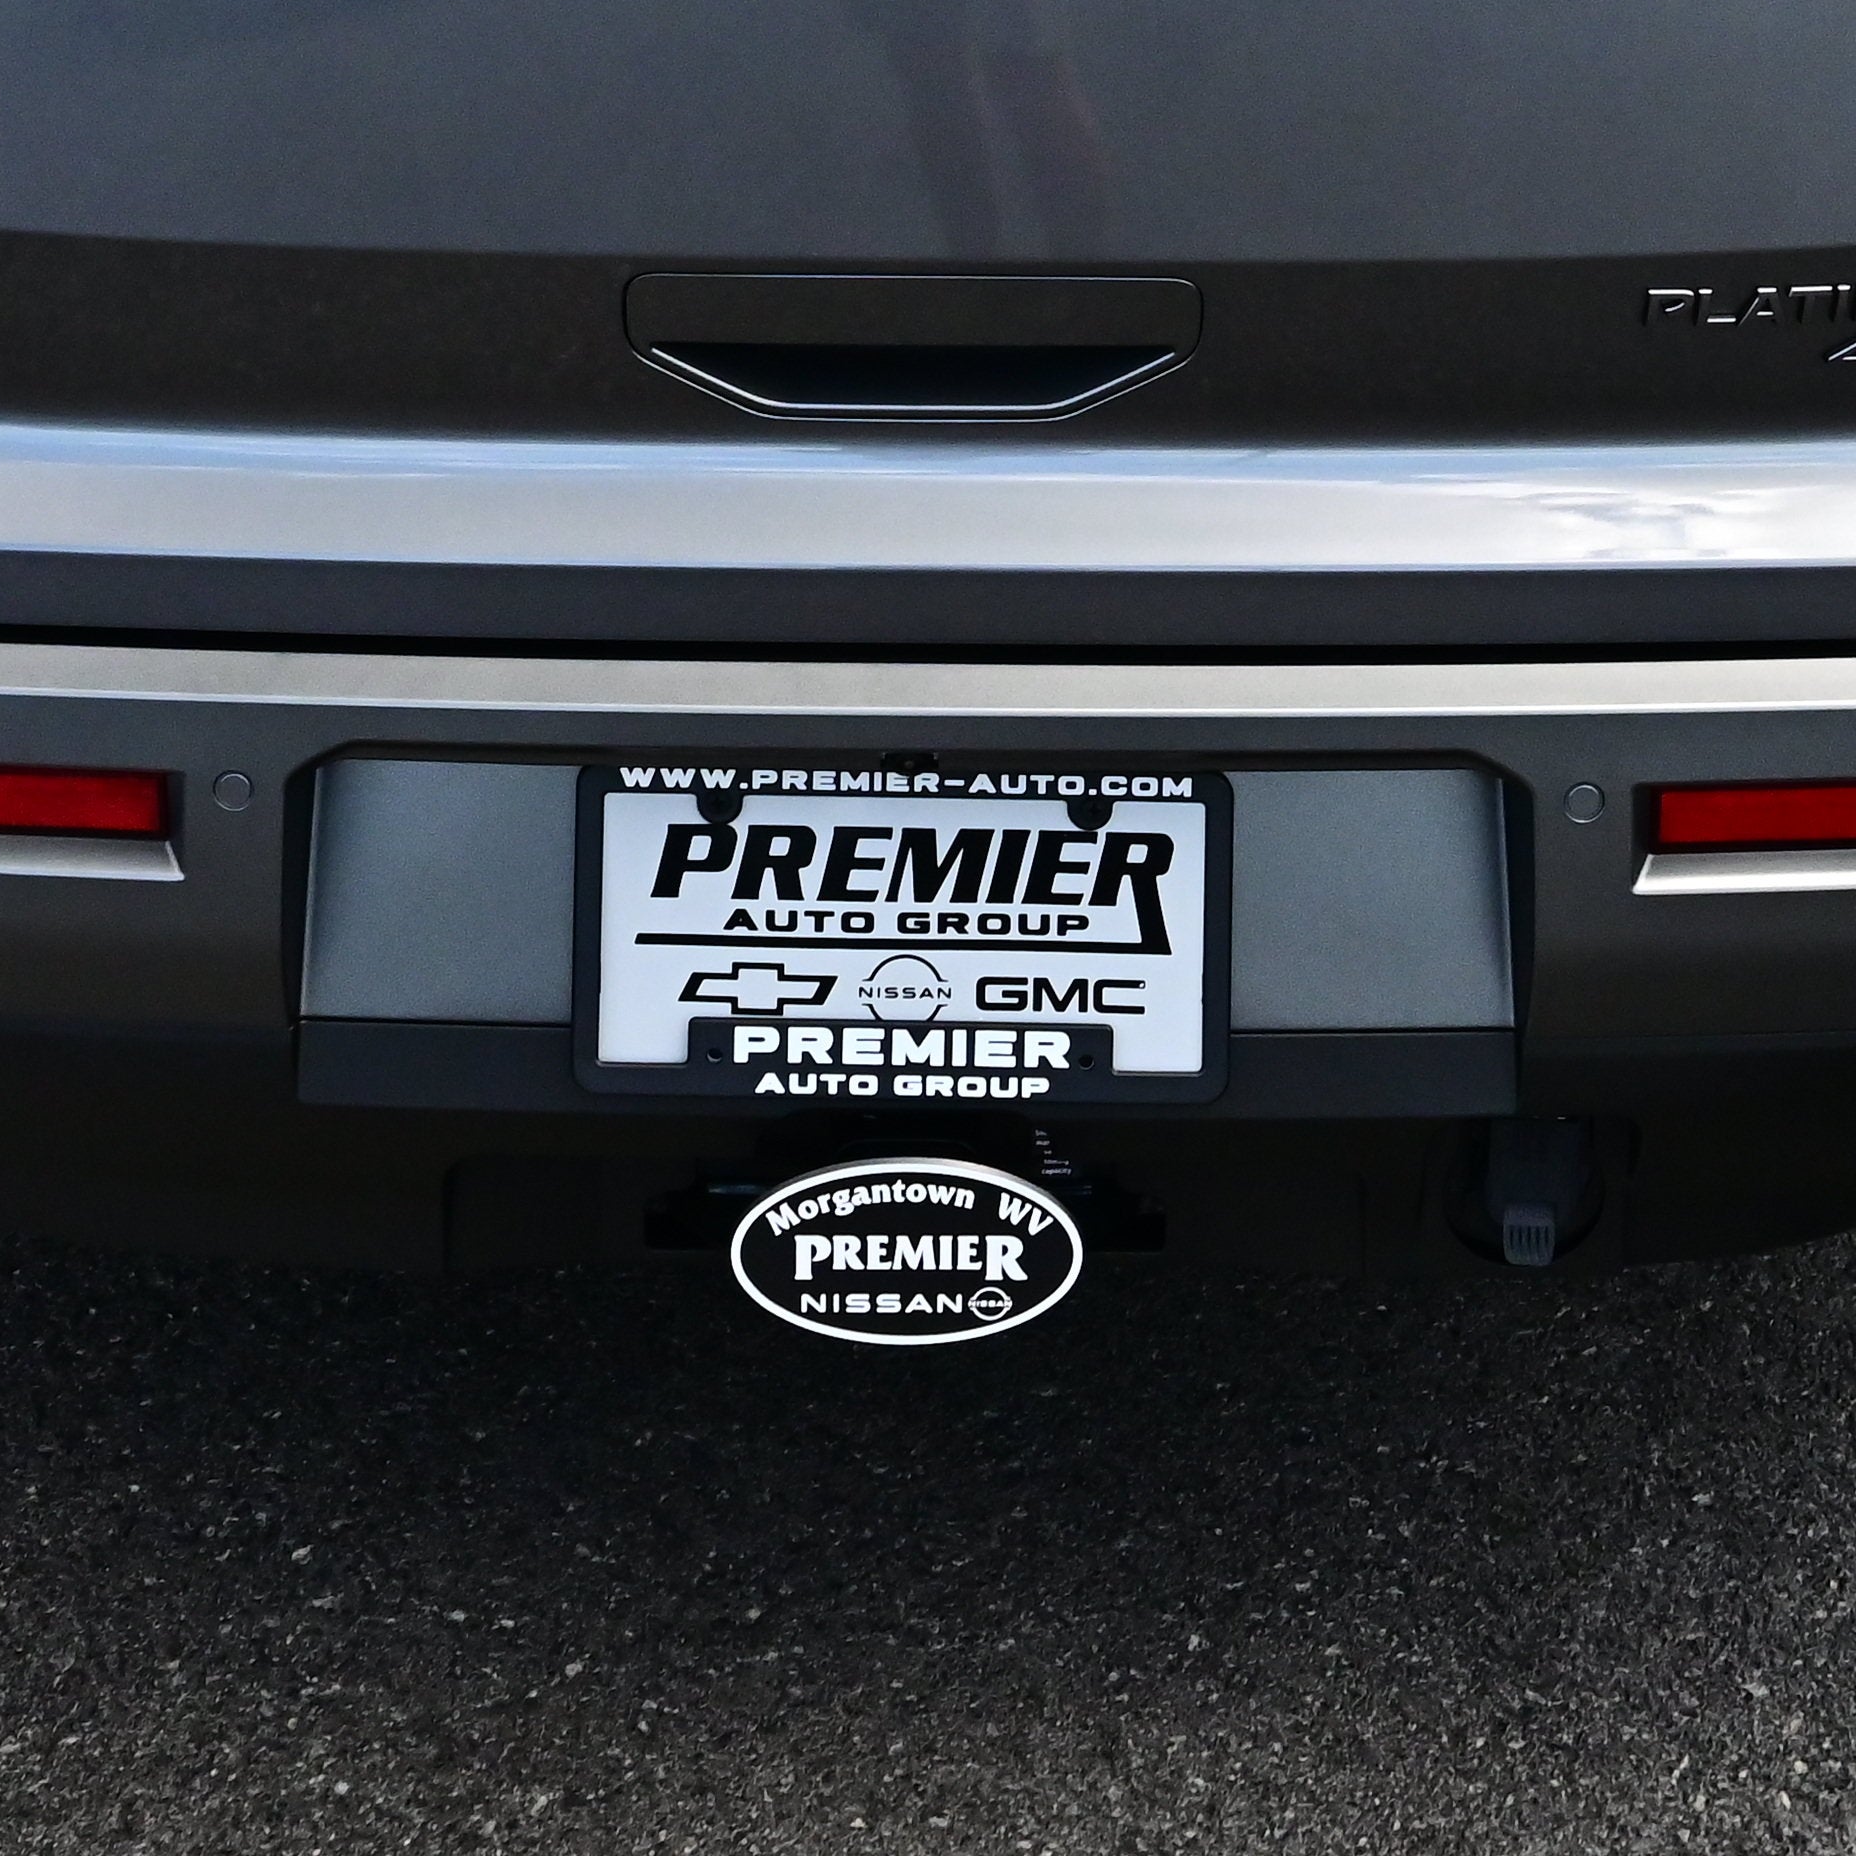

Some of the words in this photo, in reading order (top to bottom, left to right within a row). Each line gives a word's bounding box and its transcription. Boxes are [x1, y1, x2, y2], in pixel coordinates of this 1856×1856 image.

[619, 766, 1194, 799] WWW.PREMIER-AUTO.COM
[649, 822, 1175, 956] PREMIER
[722, 907, 876, 935] AUTO
[896, 910, 1091, 938] GROUP
[858, 984, 953, 1001] NISSAN
[974, 976, 1146, 1016] GMC
[733, 1025, 1071, 1070] PREMIER
[753, 1073, 880, 1097] AUTO
[892, 1074, 1050, 1100] GROUP
[764, 1179, 976, 1237] Morgantown
[997, 1192, 1055, 1237] WV
[793, 1234, 1029, 1281] PREMIER
[800, 1293, 963, 1314] NISSAN
